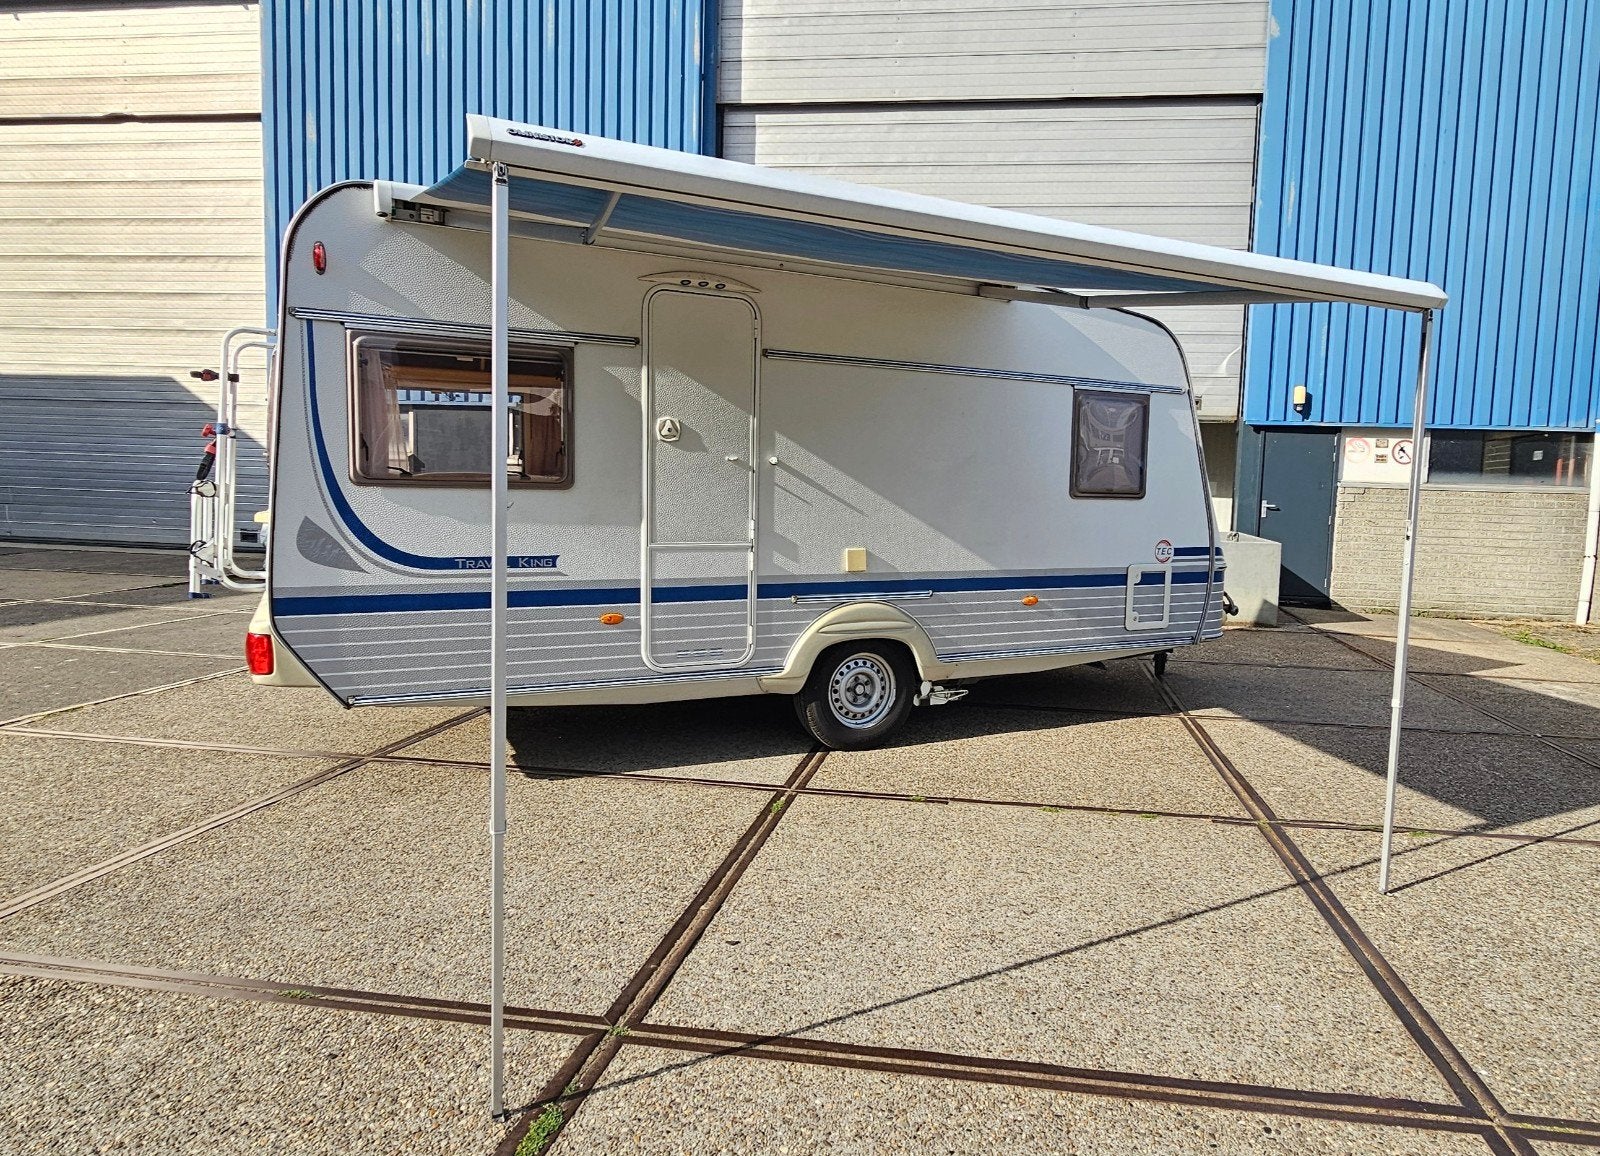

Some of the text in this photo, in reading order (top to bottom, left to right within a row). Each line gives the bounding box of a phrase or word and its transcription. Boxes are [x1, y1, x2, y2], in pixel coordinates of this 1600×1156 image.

[1156, 547, 1173, 556] TEC
[454, 557, 553, 569] TRAV KING
